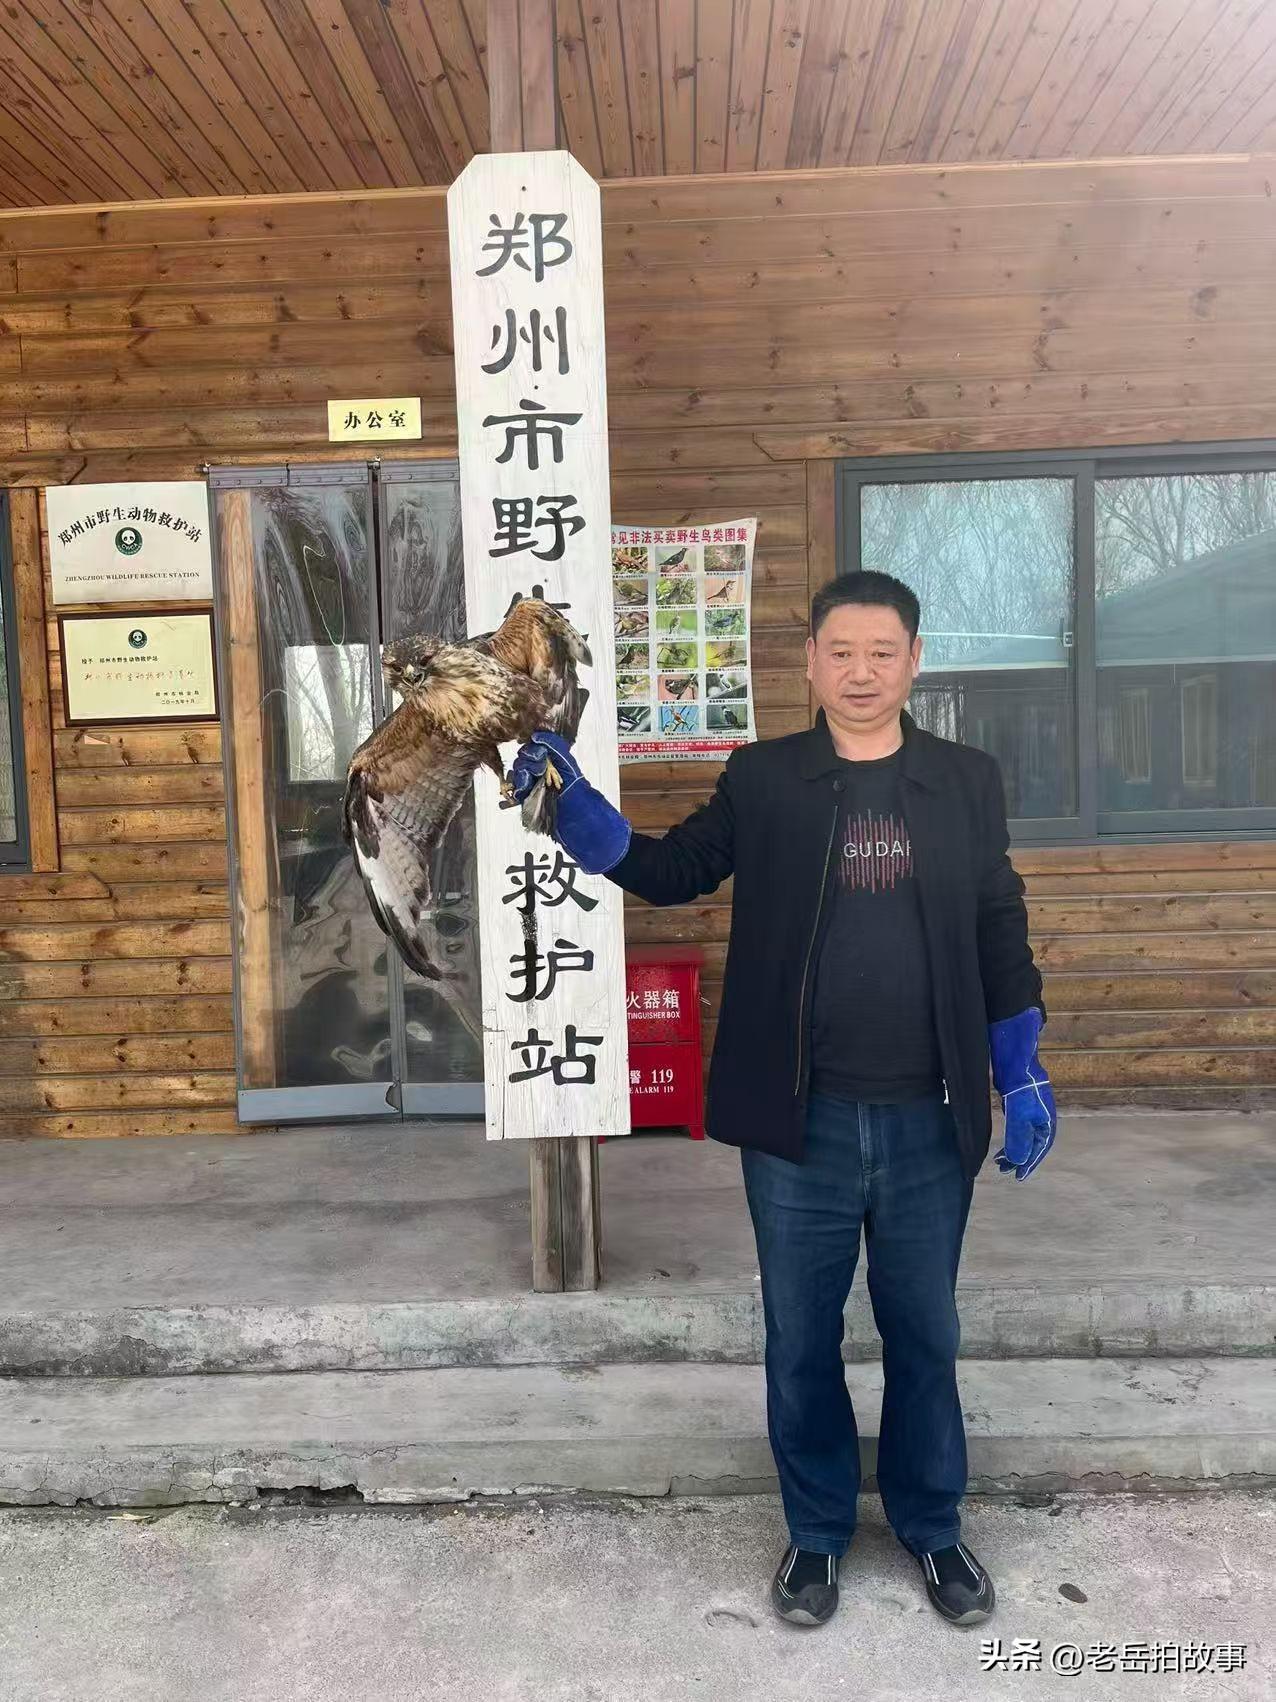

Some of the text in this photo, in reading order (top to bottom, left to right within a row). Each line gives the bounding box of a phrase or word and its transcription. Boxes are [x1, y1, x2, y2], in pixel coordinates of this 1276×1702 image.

[343, 409, 406, 430] 办公室
[57, 506, 203, 548] 郑州市野生动物救护站
[666, 1011, 680, 1019] BOX
[652, 1068, 674, 1084] 119
[635, 1086, 660, 1094] ALARM
[664, 1085, 674, 1093] 119
